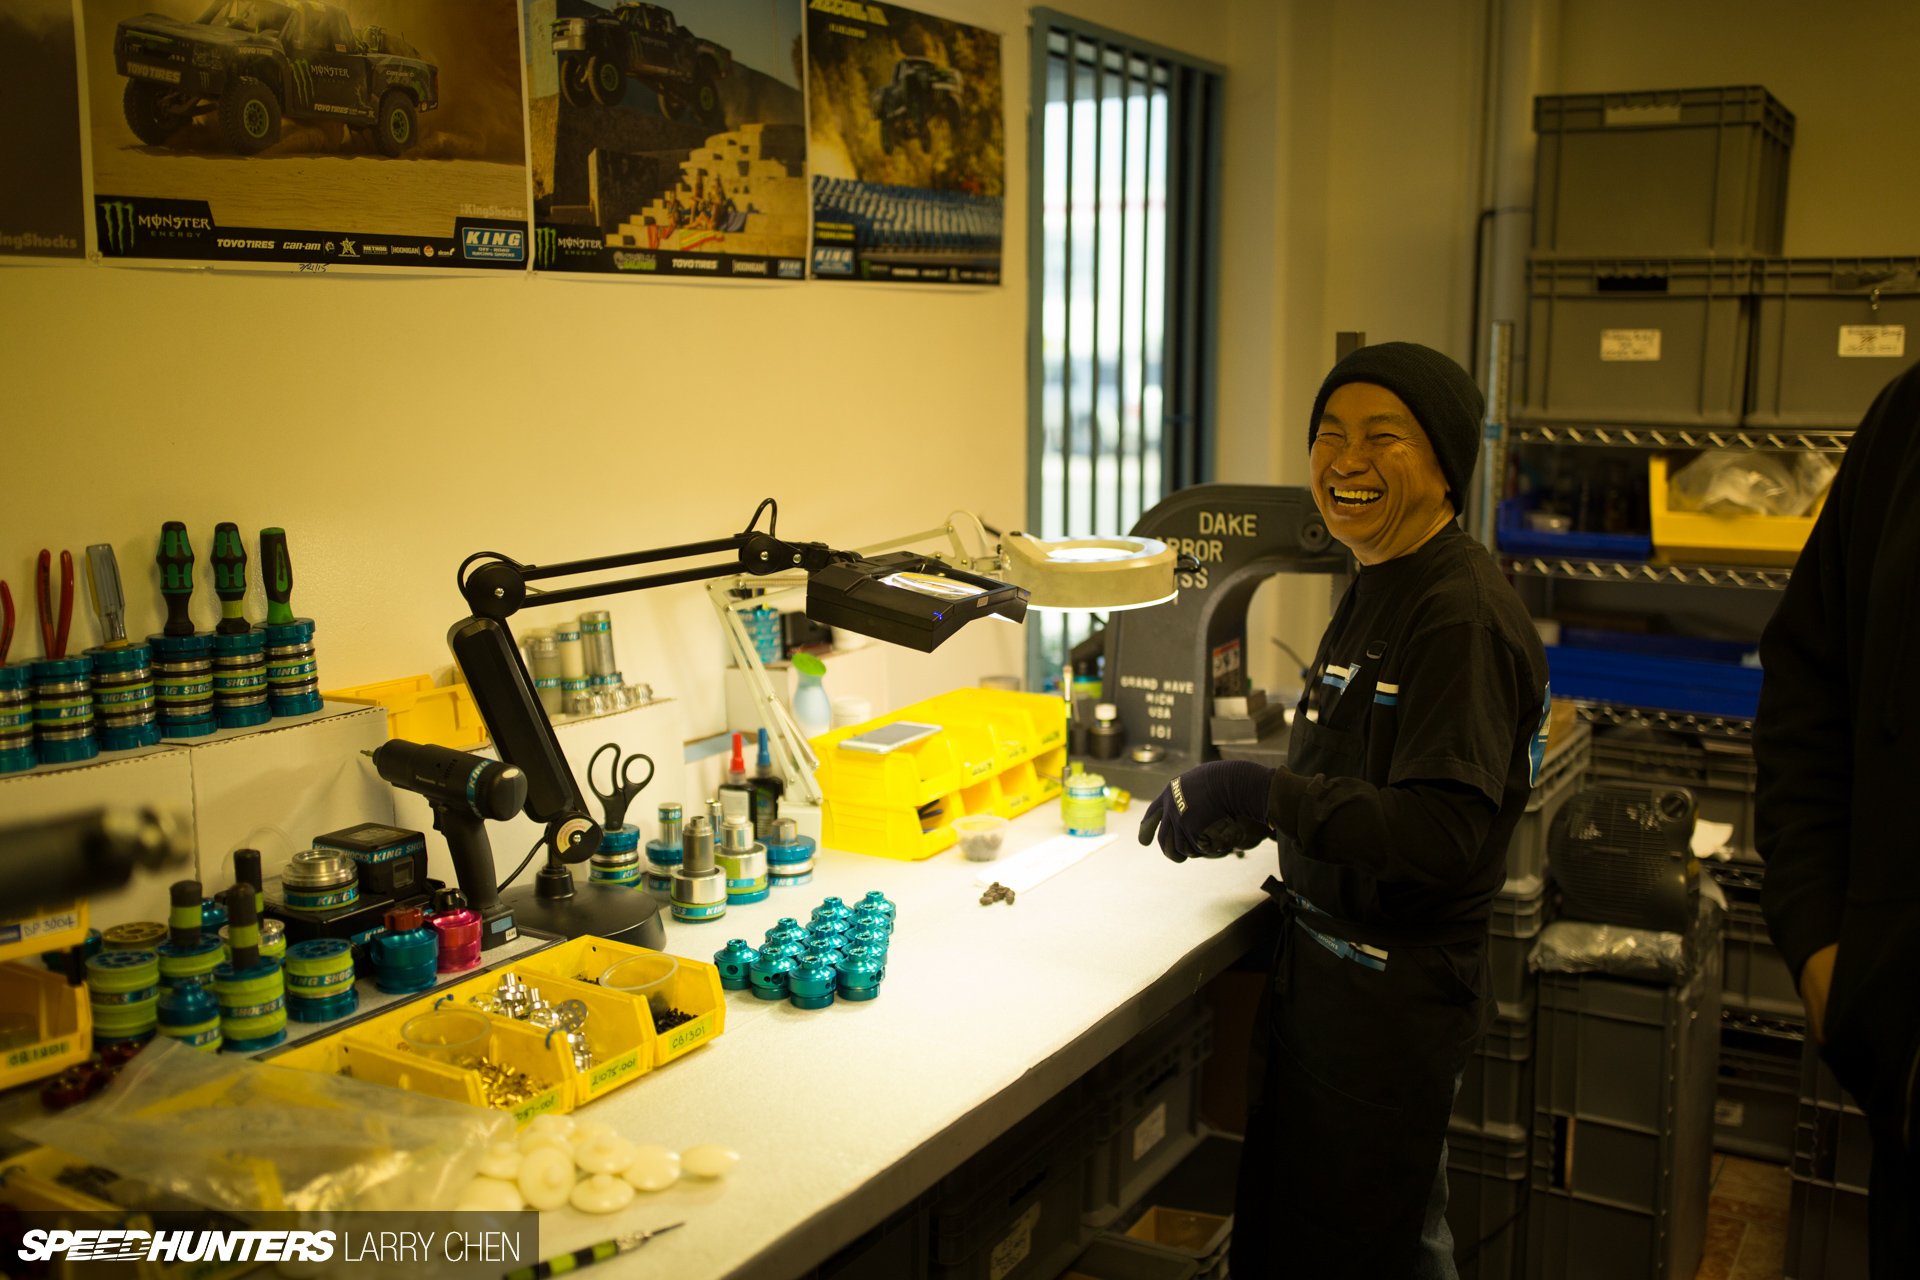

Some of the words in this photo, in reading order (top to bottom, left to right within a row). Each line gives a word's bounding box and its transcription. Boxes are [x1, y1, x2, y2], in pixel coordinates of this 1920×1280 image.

[127, 61, 149, 77] TOYO
[149, 67, 181, 84] TIRES
[310, 64, 350, 79] MONSTER
[138, 213, 211, 230] MONSTER
[0, 230, 77, 250] ngShocks
[150, 230, 201, 238] ENERGY
[465, 230, 521, 247] KING
[216, 238, 246, 248] TOYO
[246, 240, 275, 249] TIRES
[282, 241, 322, 251] can-am
[557, 236, 604, 250] MONSTER
[1199, 511, 1258, 538] DAKE
[1155, 536, 1224, 563] RBOR
[268, 665, 300, 679] KING
[225, 676, 264, 688] SHOCKS
[1120, 675, 1159, 691] GRAND
[59, 704, 92, 719] KING
[1147, 705, 1172, 719] USA
[469, 759, 491, 789] KING
[1172, 778, 1187, 813] ULINE
[372, 847, 403, 864] KING
[316, 889, 351, 907] KING
[231, 1000, 277, 1018] SHOCKS
